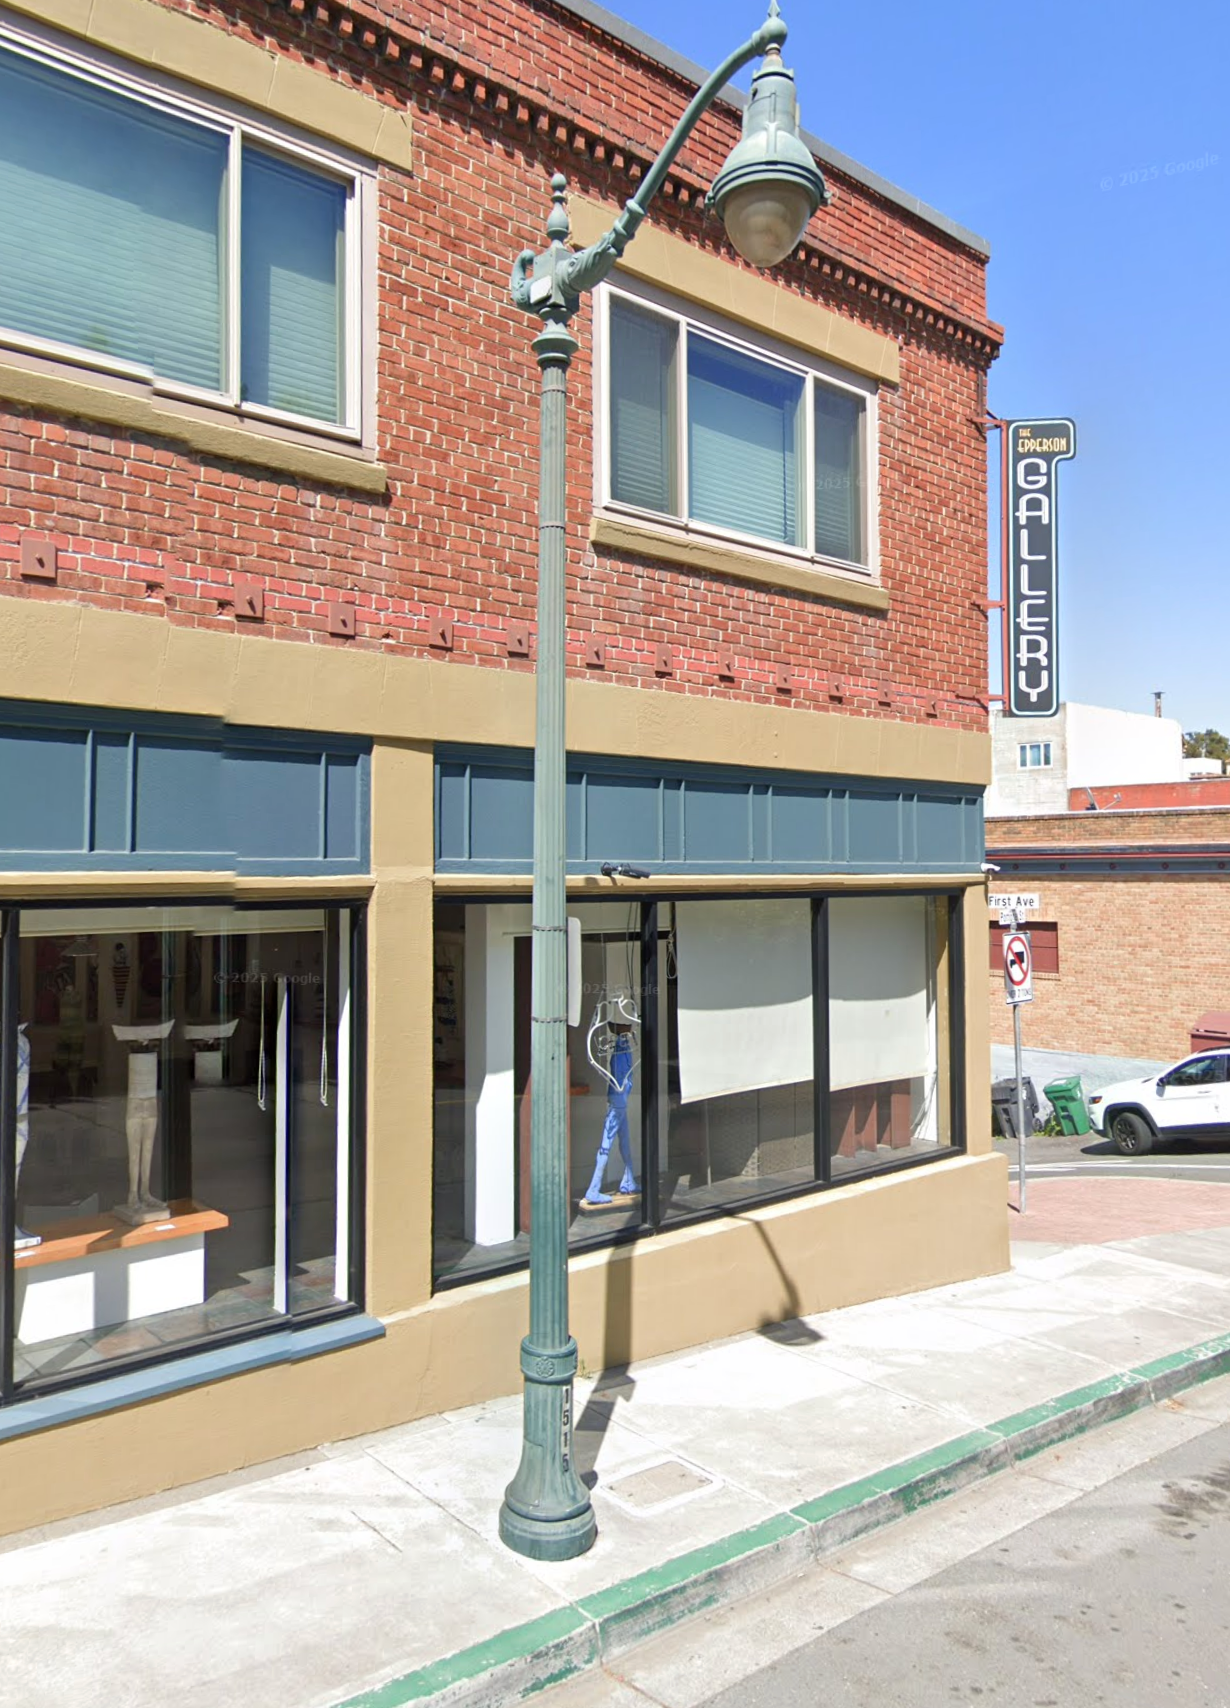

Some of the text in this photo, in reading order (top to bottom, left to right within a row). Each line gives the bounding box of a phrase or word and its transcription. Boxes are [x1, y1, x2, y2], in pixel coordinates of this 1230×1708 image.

[1018, 428, 1031, 437] THE
[1017, 437, 1067, 453] EPPERSON
[1015, 457, 1050, 702] GALLERY
[988, 895, 1035, 907] First Ave
[561, 1387, 571, 1473] 1515
